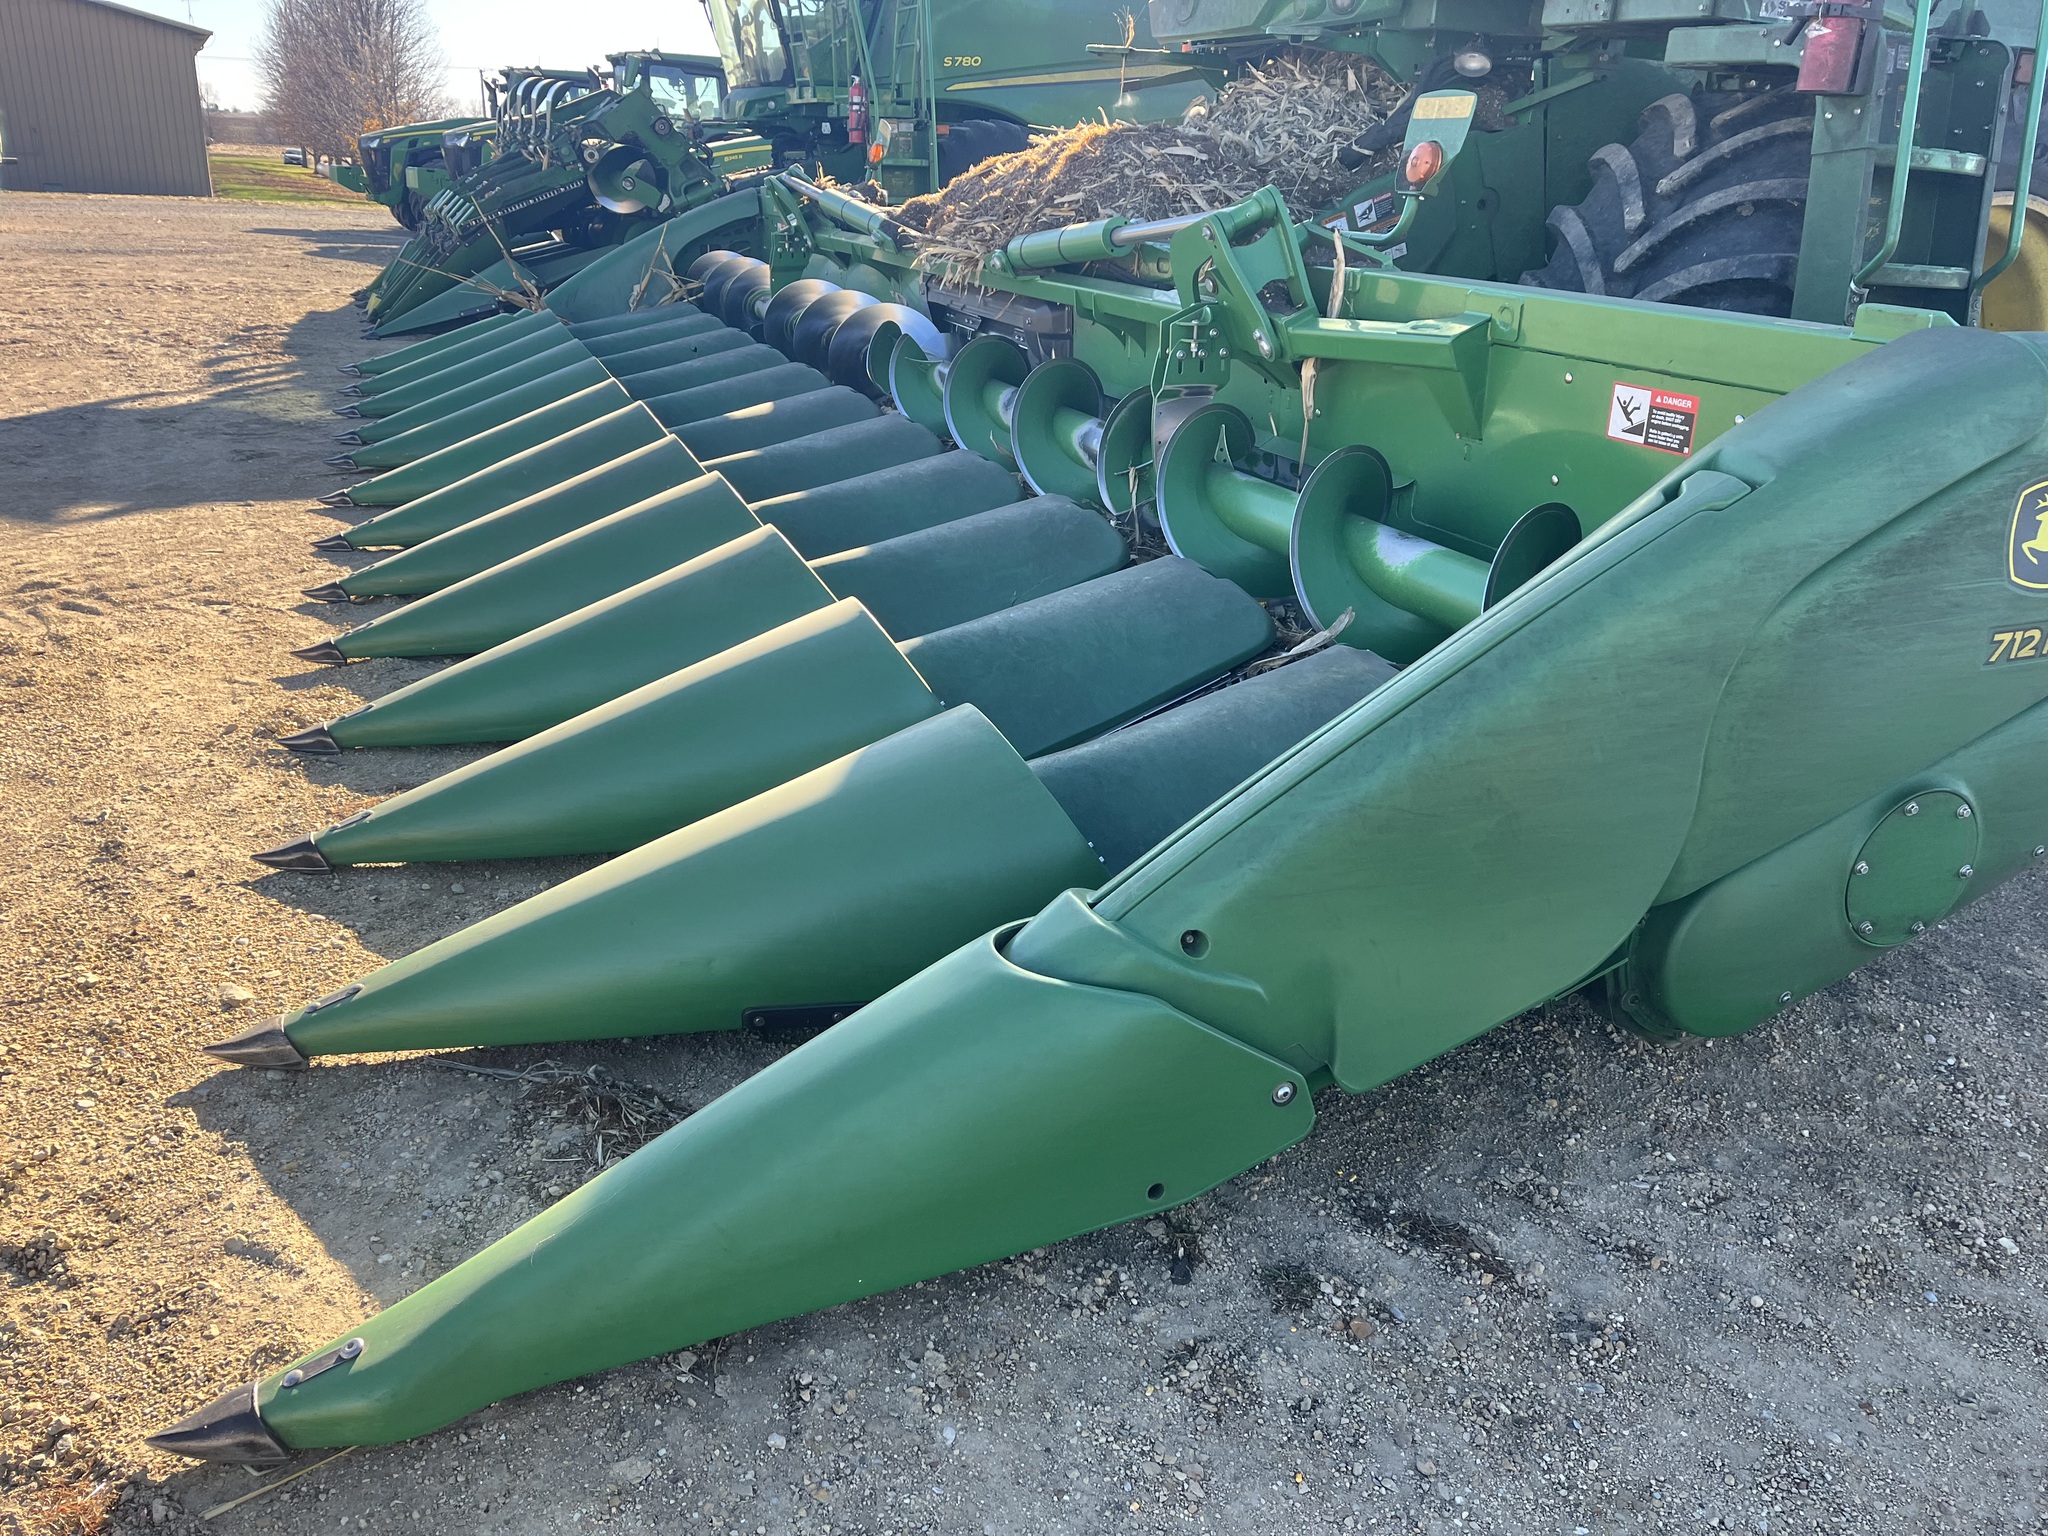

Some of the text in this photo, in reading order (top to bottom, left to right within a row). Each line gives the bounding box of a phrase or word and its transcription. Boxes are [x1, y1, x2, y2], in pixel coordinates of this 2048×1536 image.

[944, 56, 982, 67] S 780
[1662, 396, 1692, 408] DANGER
